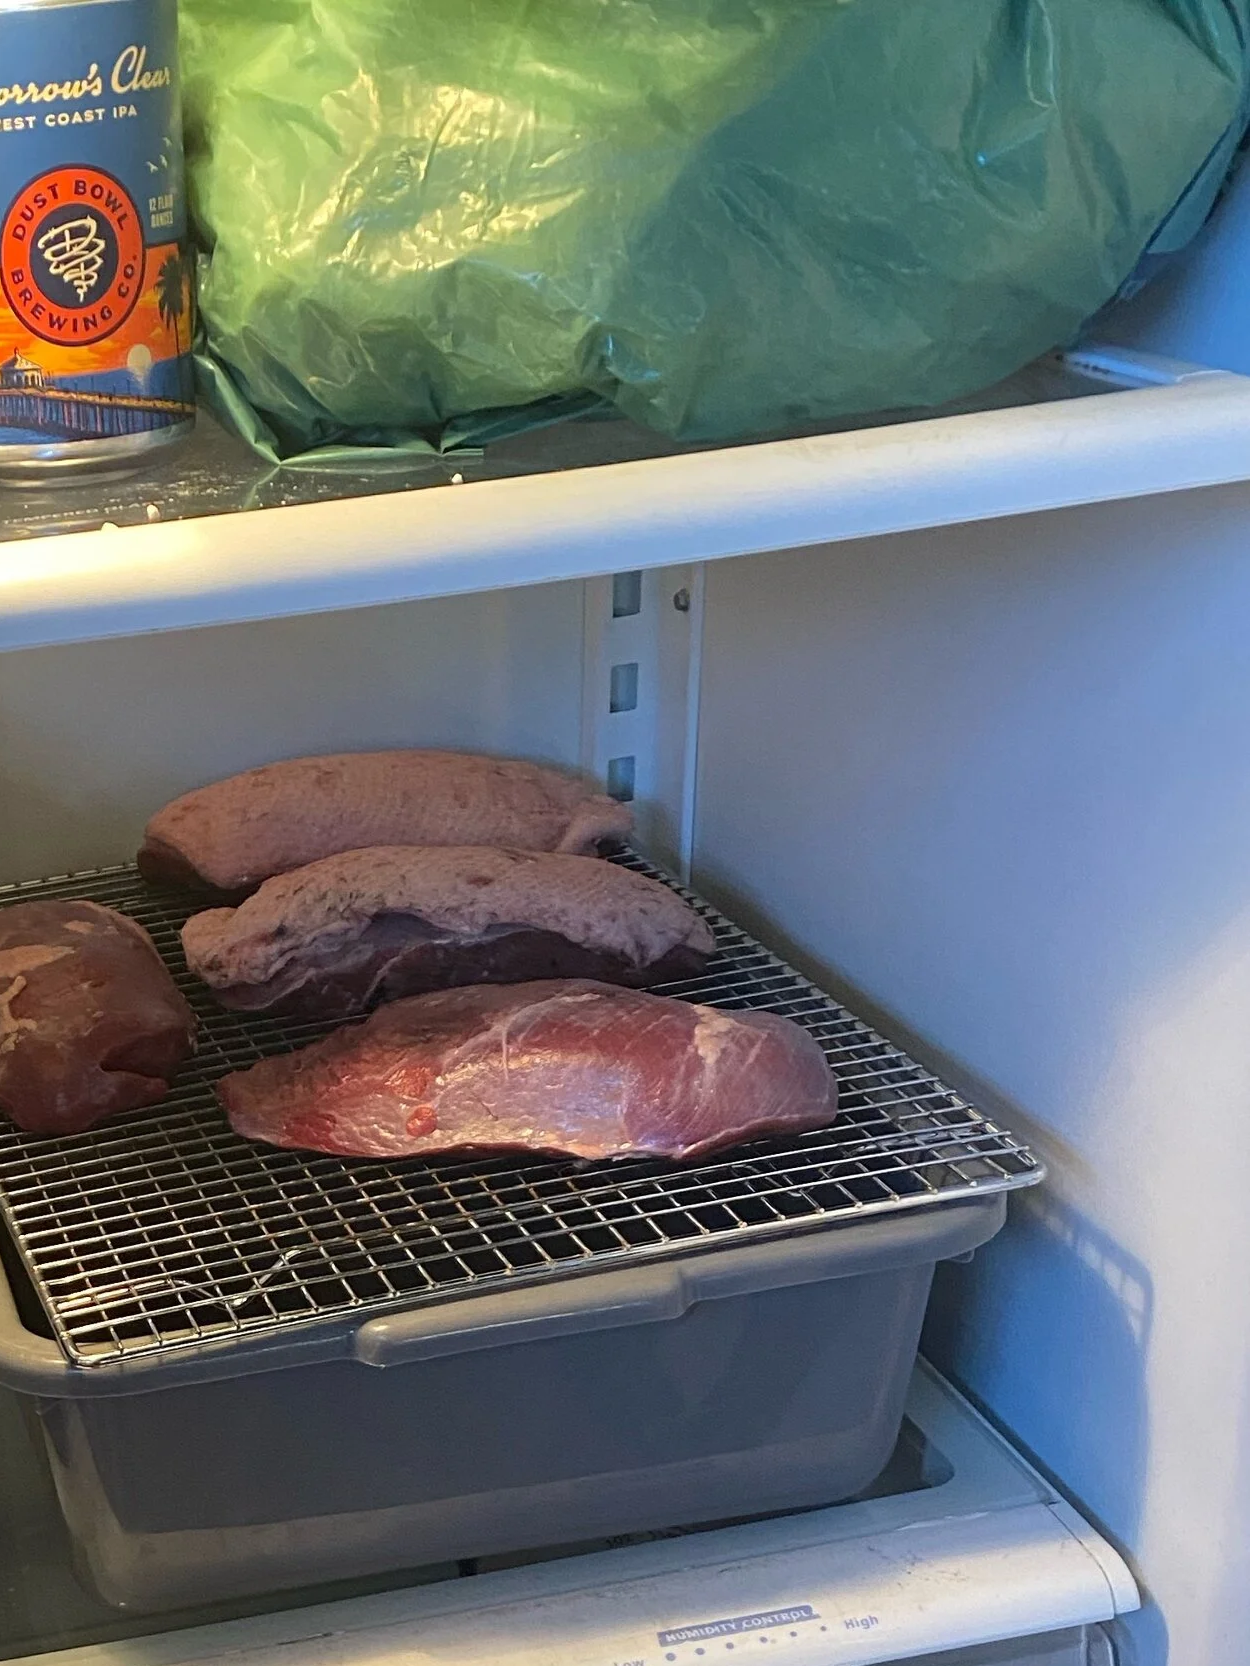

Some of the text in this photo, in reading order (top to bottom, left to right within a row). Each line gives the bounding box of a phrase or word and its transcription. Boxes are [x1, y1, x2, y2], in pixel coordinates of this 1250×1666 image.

[45, 108, 106, 127] COAST
[113, 104, 138, 119] IPA
[12, 180, 129, 241] DUST BOWL
[11, 254, 137, 332] BREWING CO.
[666, 1608, 810, 1643] HUMIDITY CONTROL
[844, 1615, 878, 1631] High
